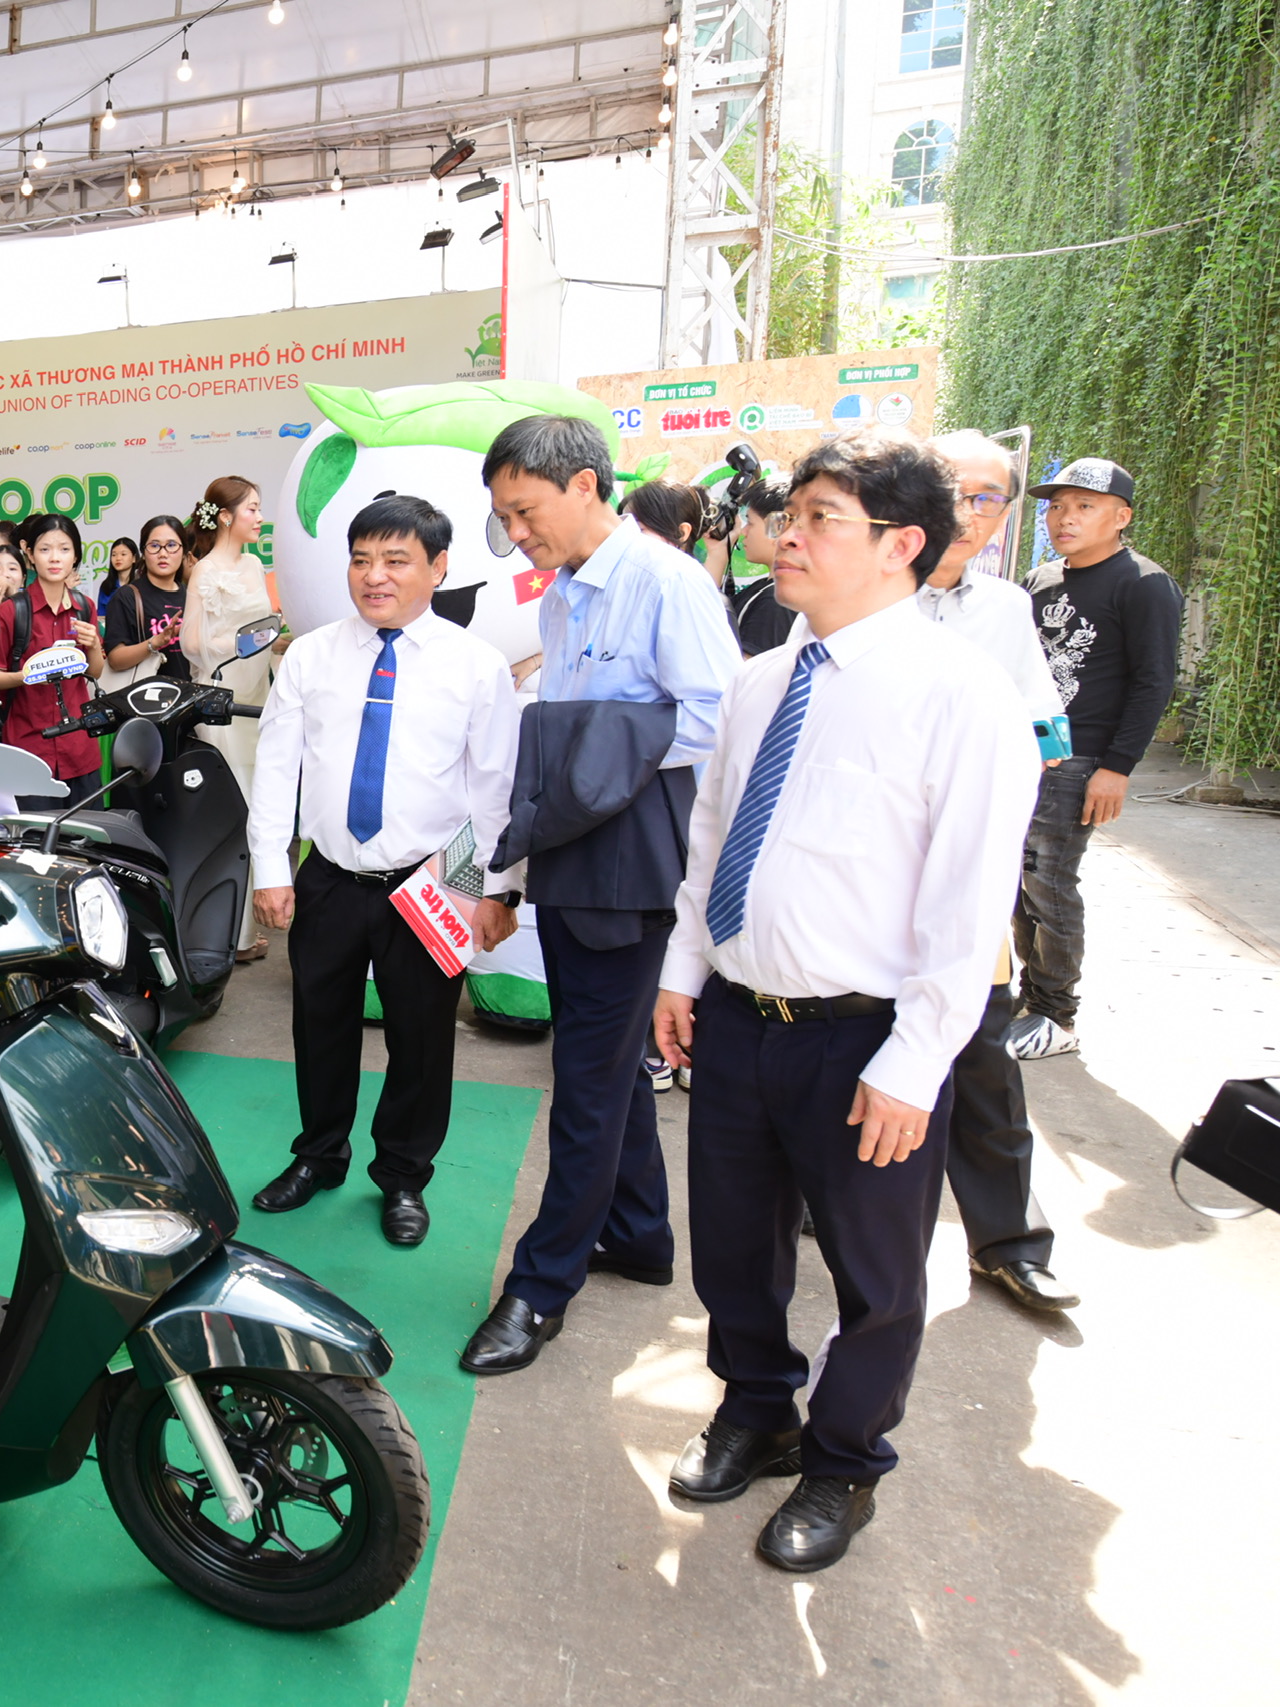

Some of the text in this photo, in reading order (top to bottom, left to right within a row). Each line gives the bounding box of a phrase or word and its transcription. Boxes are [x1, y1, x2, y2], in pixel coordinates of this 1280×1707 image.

[10, 369, 32, 388] XÃ
[37, 365, 116, 387] THƯƠNG
[121, 361, 154, 382] MẠI
[158, 354, 223, 375] THÀNH
[230, 343, 271, 369] PHỐ
[276, 340, 306, 365] HỒ
[311, 338, 347, 361] CHÍ
[352, 336, 407, 358] MINH
[456, 371, 475, 379] MAKE
[51, 394, 74, 409] OF
[76, 386, 151, 407] TRADING
[155, 373, 299, 400] CO-OPERATIVES
[124, 437, 147, 446] SCID
[30, 654, 77, 672] FELIZ LITE
